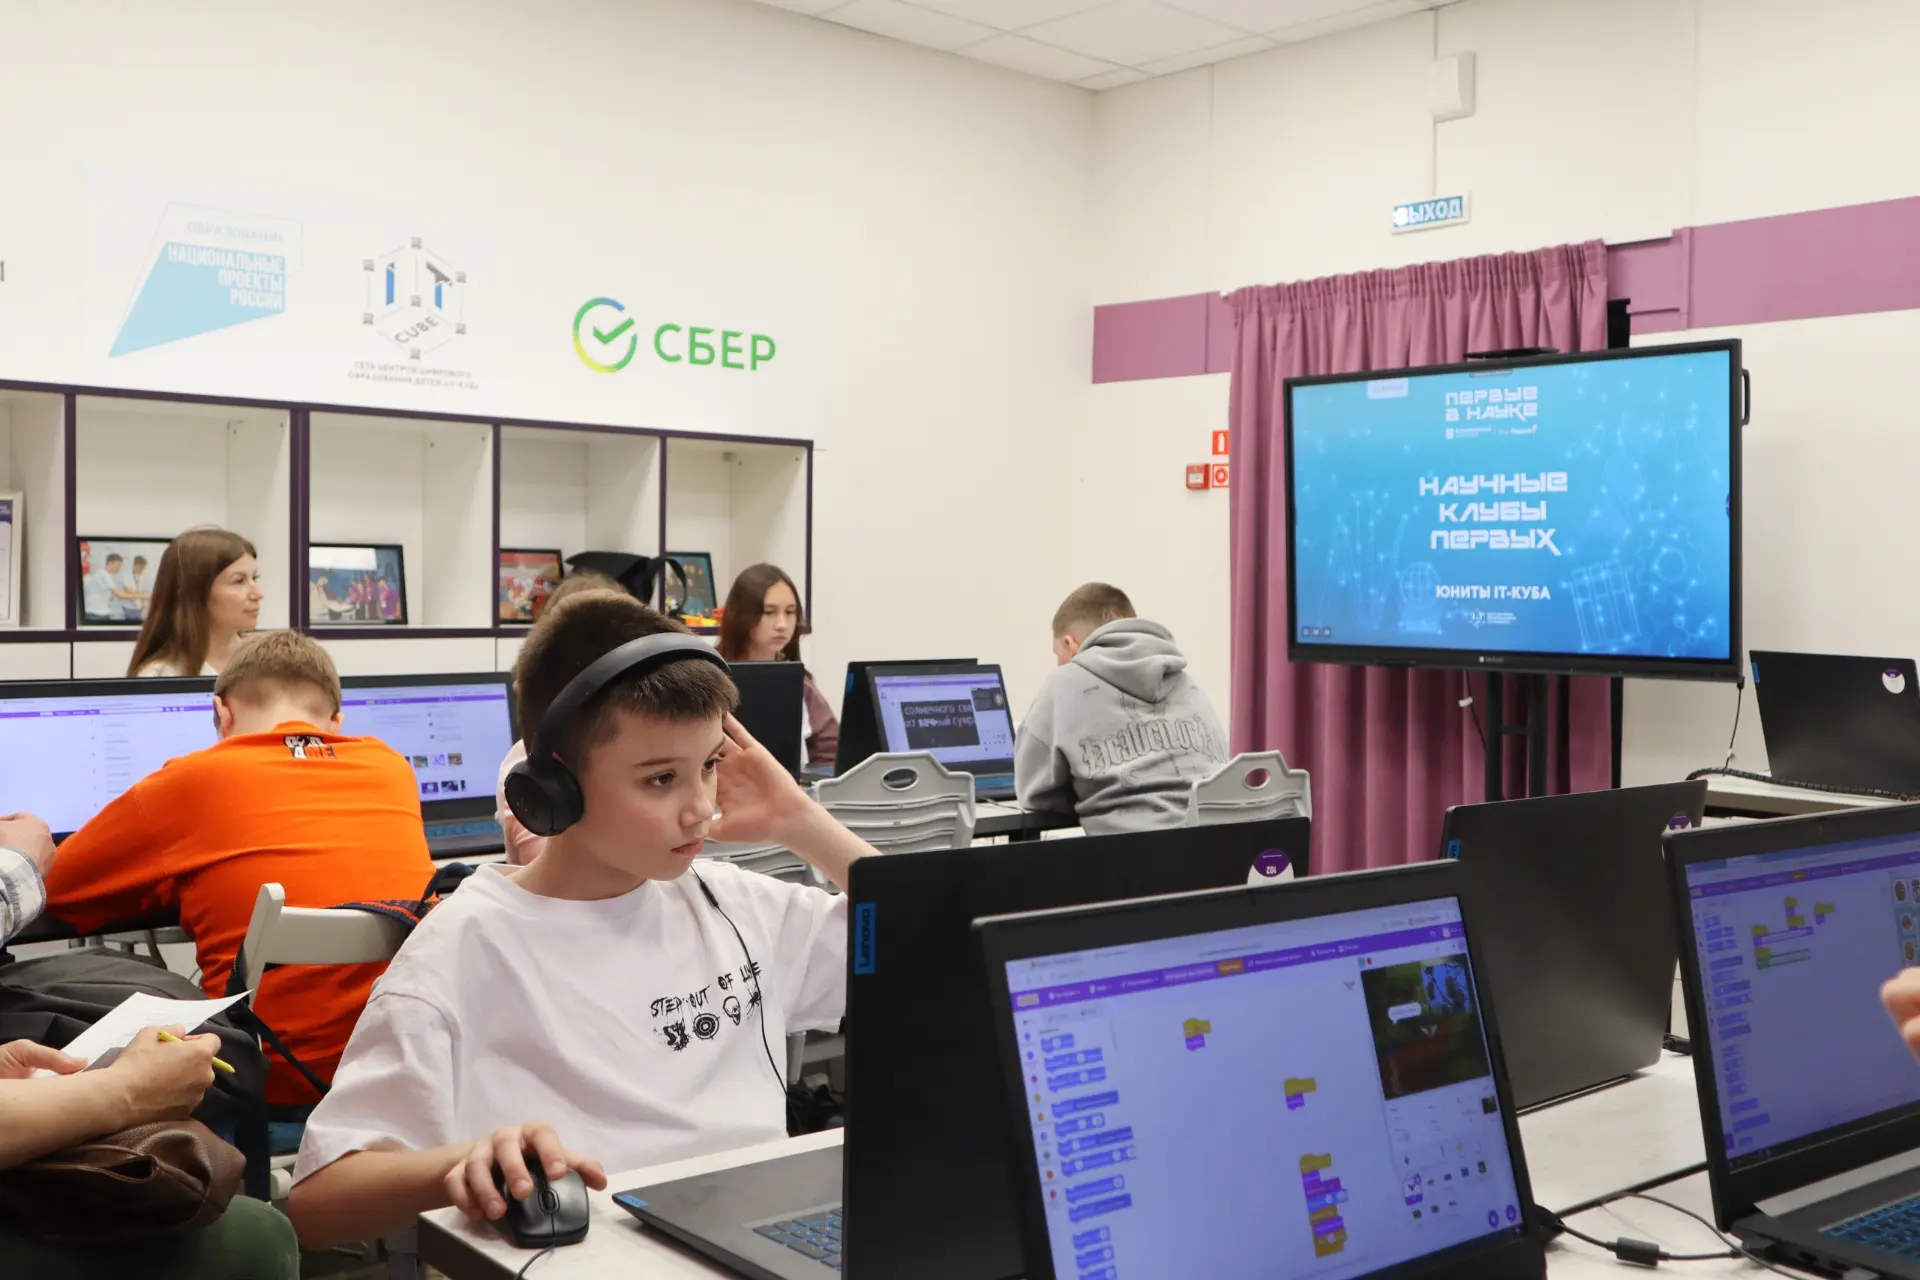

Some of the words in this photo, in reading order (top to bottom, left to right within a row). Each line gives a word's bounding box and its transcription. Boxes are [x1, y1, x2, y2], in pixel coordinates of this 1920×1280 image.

[1394, 199, 1461, 225] ЫХОД
[167, 243, 284, 274] НАЦИОНАЛЬНЫЕ
[218, 270, 284, 292] ПРОЕКТЫ
[230, 287, 284, 310] РОССИИ
[394, 316, 438, 343] CUBE
[654, 323, 776, 371] СБЕР
[1445, 386, 1538, 406] ПЕРВЫЕ
[1466, 402, 1538, 423] НАУКЕ
[1419, 472, 1568, 496] НАУЧНЫЕ
[1439, 500, 1547, 523] КЛУБЫ
[1430, 528, 1562, 556] ПЕРВЫХ
[1436, 585, 1490, 599] ЮНИТЫ
[1494, 585, 1551, 600] IT-КУБА
[650, 996, 682, 1018] STEP
[689, 984, 711, 1008] OUT
[717, 973, 734, 991] OF
